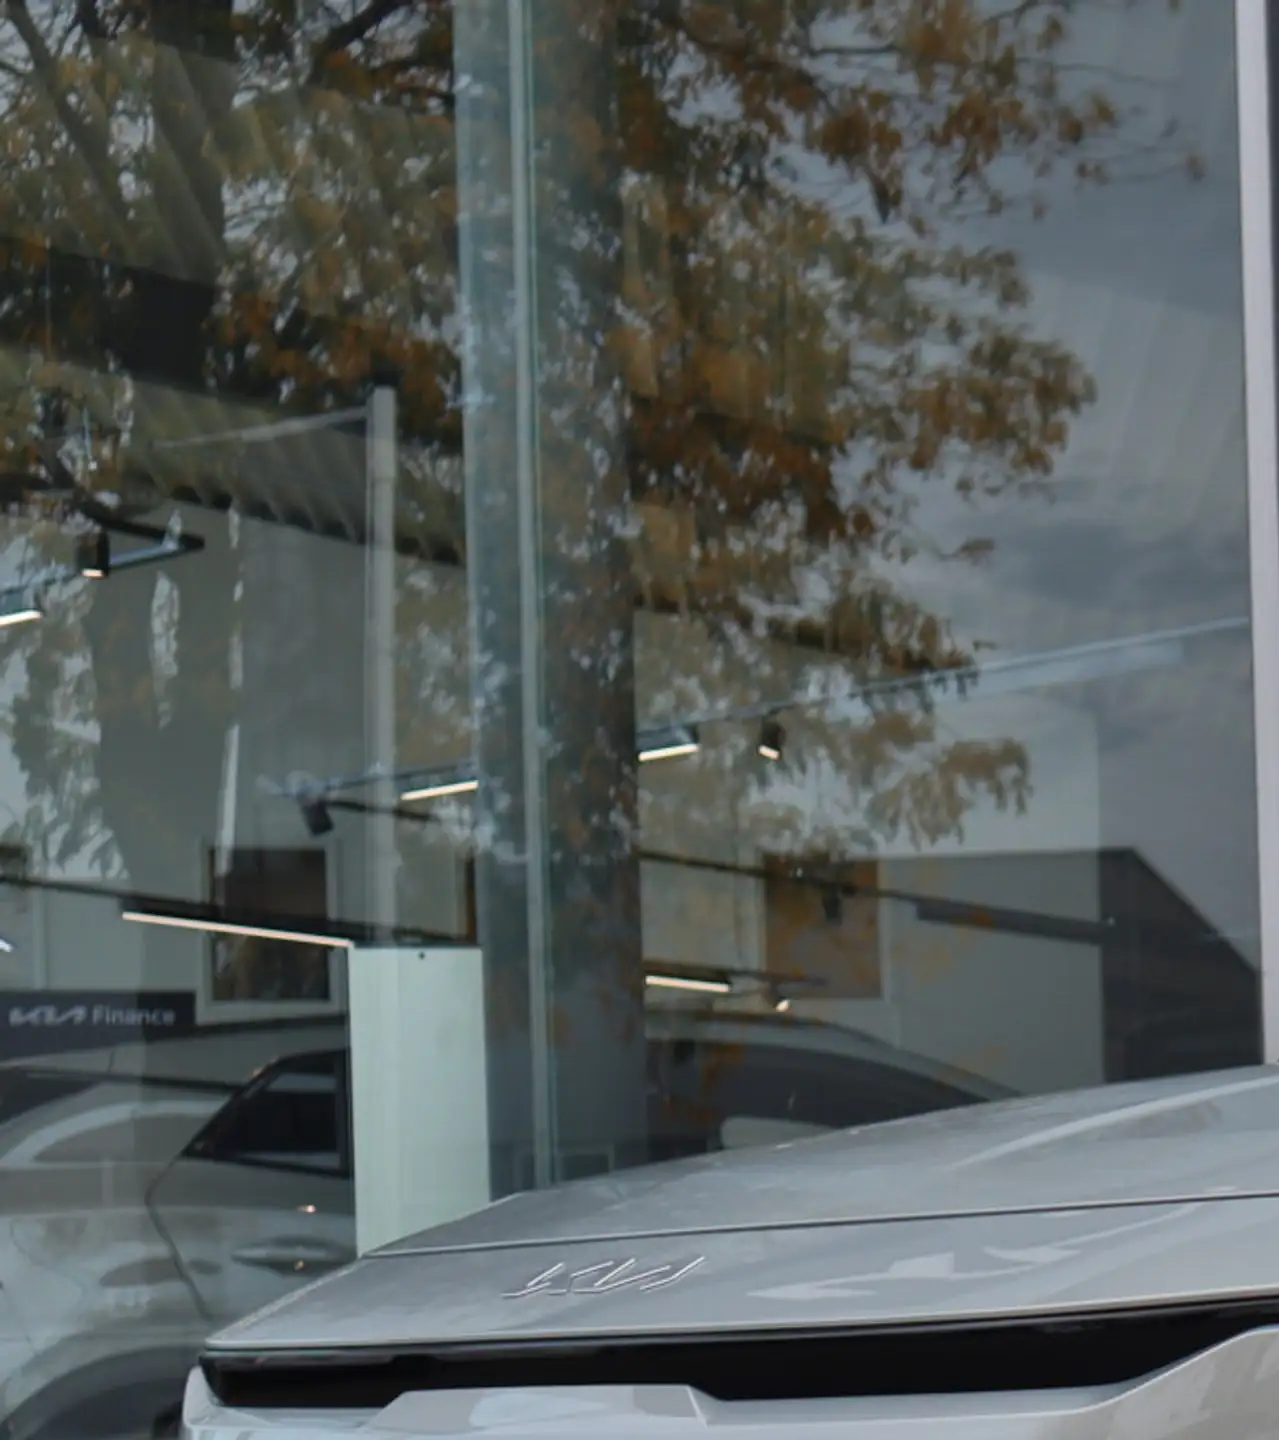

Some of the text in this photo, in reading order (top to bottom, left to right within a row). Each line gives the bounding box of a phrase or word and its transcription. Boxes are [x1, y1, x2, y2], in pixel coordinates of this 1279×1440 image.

[8, 1003, 176, 1027] KIA Finance
[501, 1255, 706, 1299] KIA
